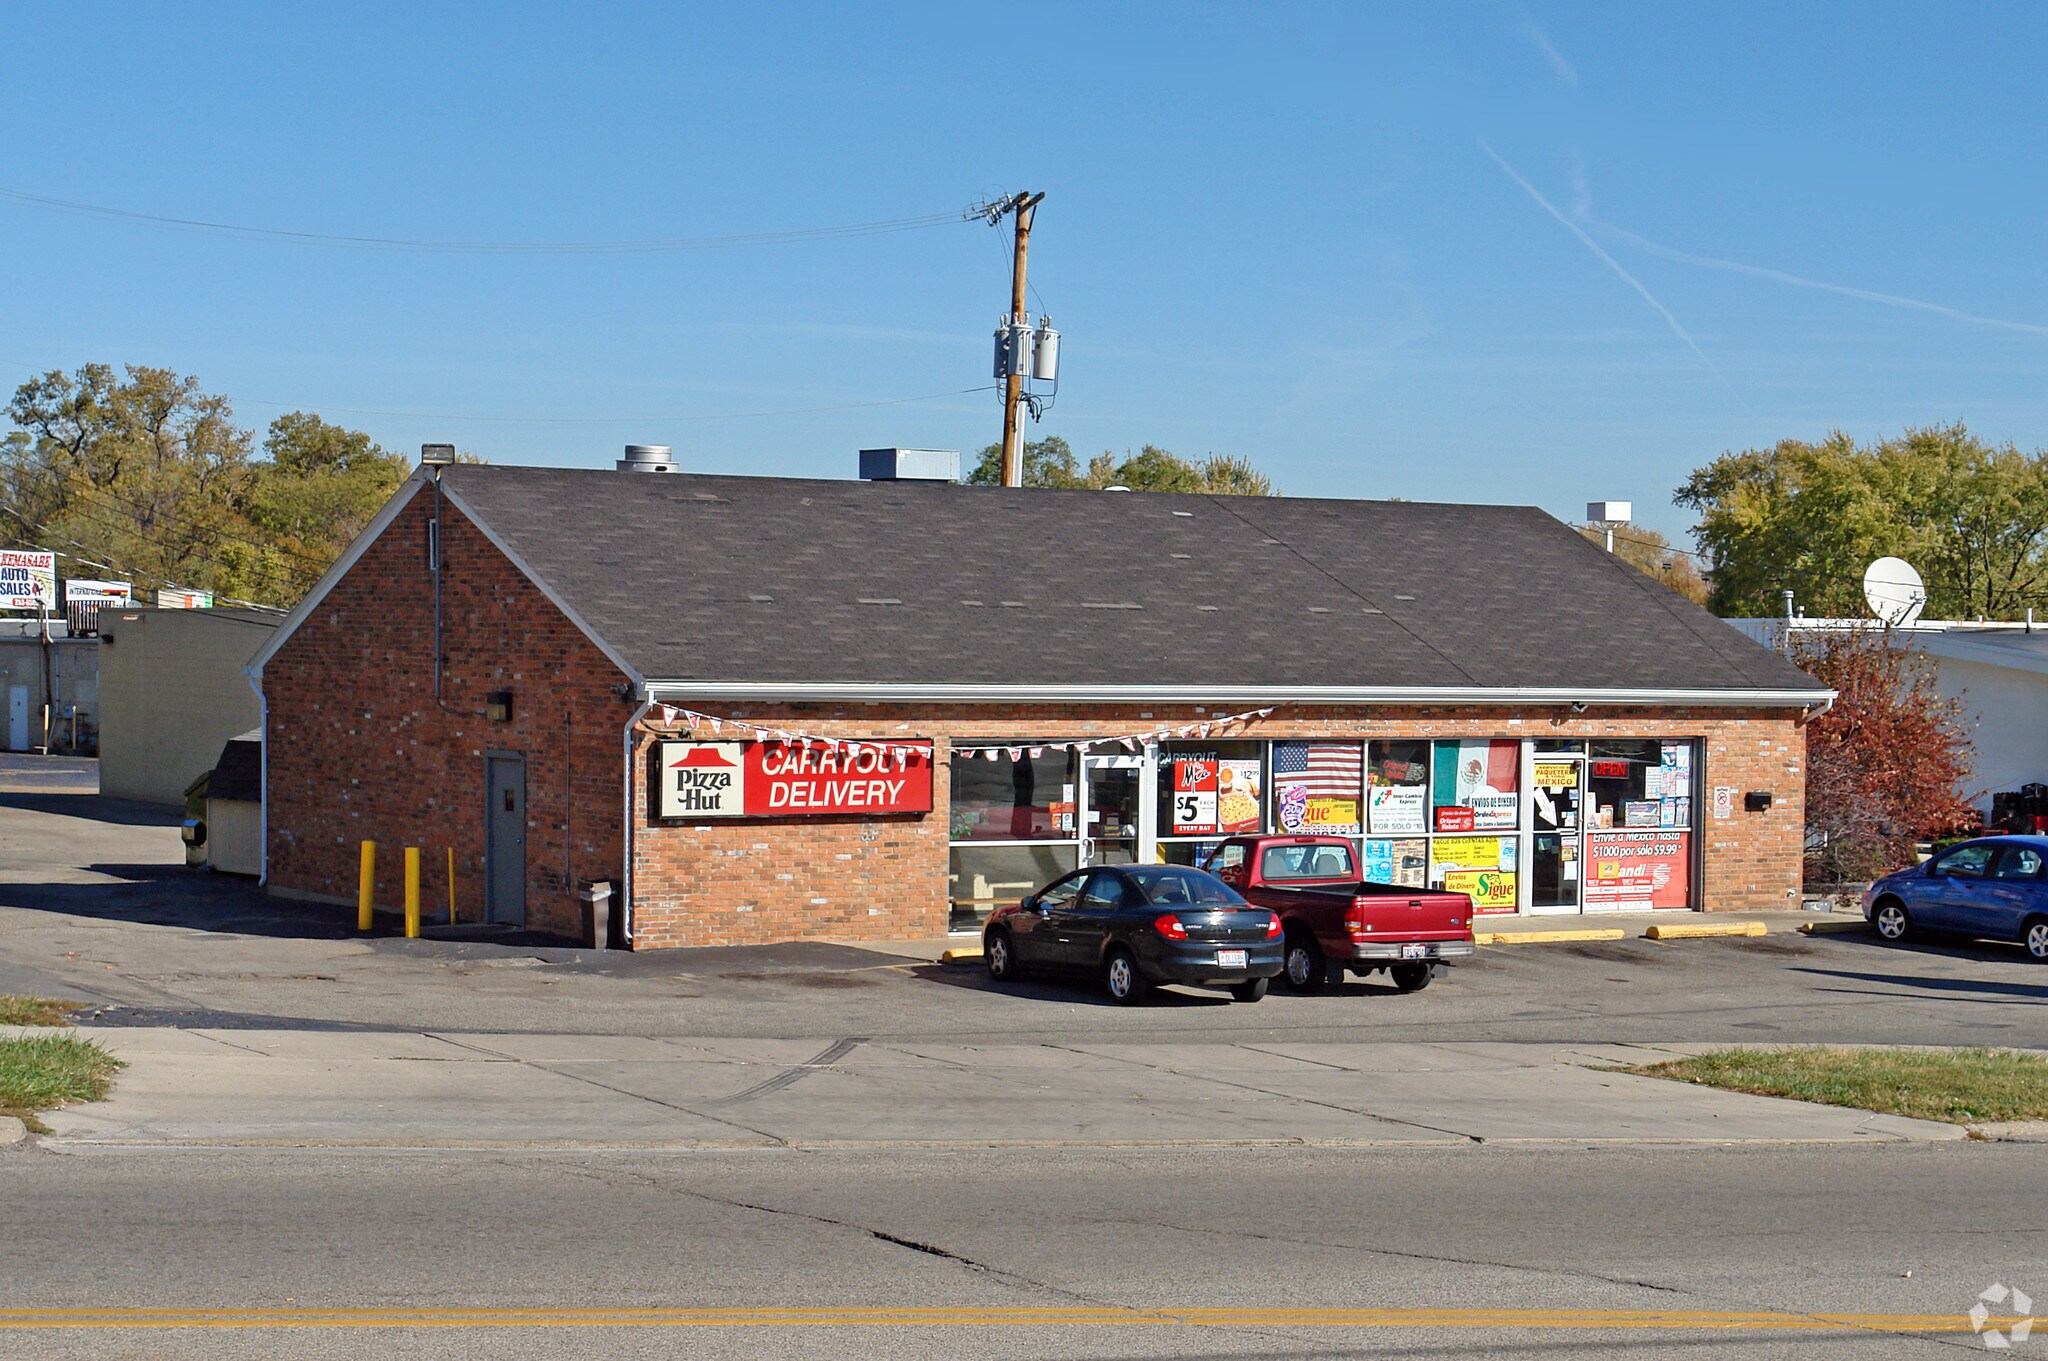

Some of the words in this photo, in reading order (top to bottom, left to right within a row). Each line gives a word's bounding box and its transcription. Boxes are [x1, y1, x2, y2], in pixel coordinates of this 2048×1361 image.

[1, 568, 29, 581] AUTO
[0, 582, 31, 596] SALES
[761, 747, 915, 776] CARRYOUT
[1594, 761, 1627, 777] OPEN
[676, 767, 732, 791] Pizza
[677, 788, 722, 811] Hut
[768, 779, 906, 808] DELIVERY
[1176, 796, 1199, 822] $5
[1373, 822, 1389, 830] POR
[1391, 822, 1412, 830] SOLO
[1617, 833, 1624, 841] a
[1592, 846, 1620, 859] $1000
[1619, 846, 1635, 860] por
[1636, 843, 1653, 855] sólo
[1456, 882, 1475, 890] Dinero
[1476, 873, 1514, 900] Sigue
